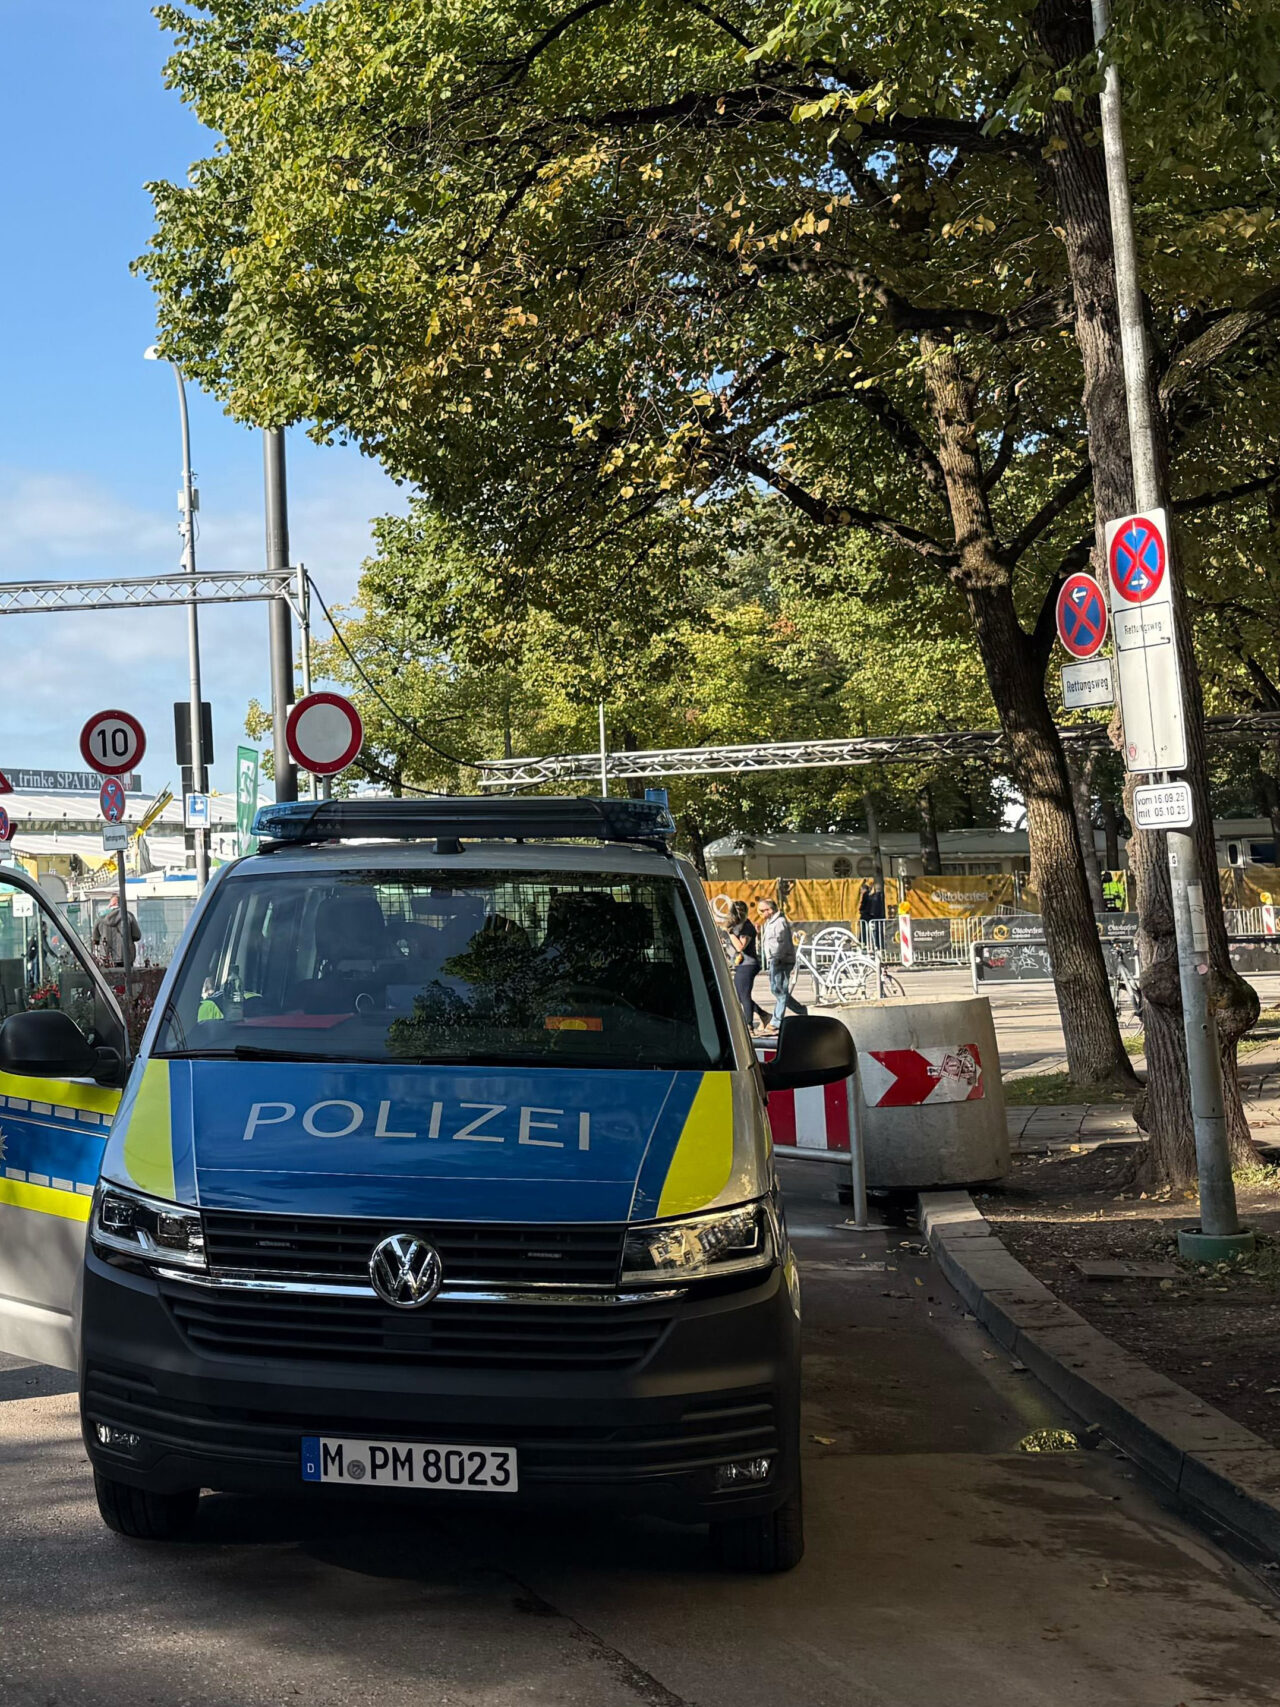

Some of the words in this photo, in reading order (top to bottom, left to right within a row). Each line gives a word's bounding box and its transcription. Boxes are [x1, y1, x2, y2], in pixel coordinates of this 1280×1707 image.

[1066, 678, 1108, 693] Rettungsweg
[97, 728, 129, 758] 10
[19, 773, 55, 787] trinke
[57, 773, 104, 789] SPATEN
[1137, 797, 1153, 806] vom
[1154, 792, 1185, 804] 16.09.25
[1138, 809, 1151, 818] mit
[242, 1099, 591, 1151] POLIZEI
[322, 1442, 344, 1477] M
[368, 1446, 414, 1482] PM
[422, 1449, 511, 1486] 8023
